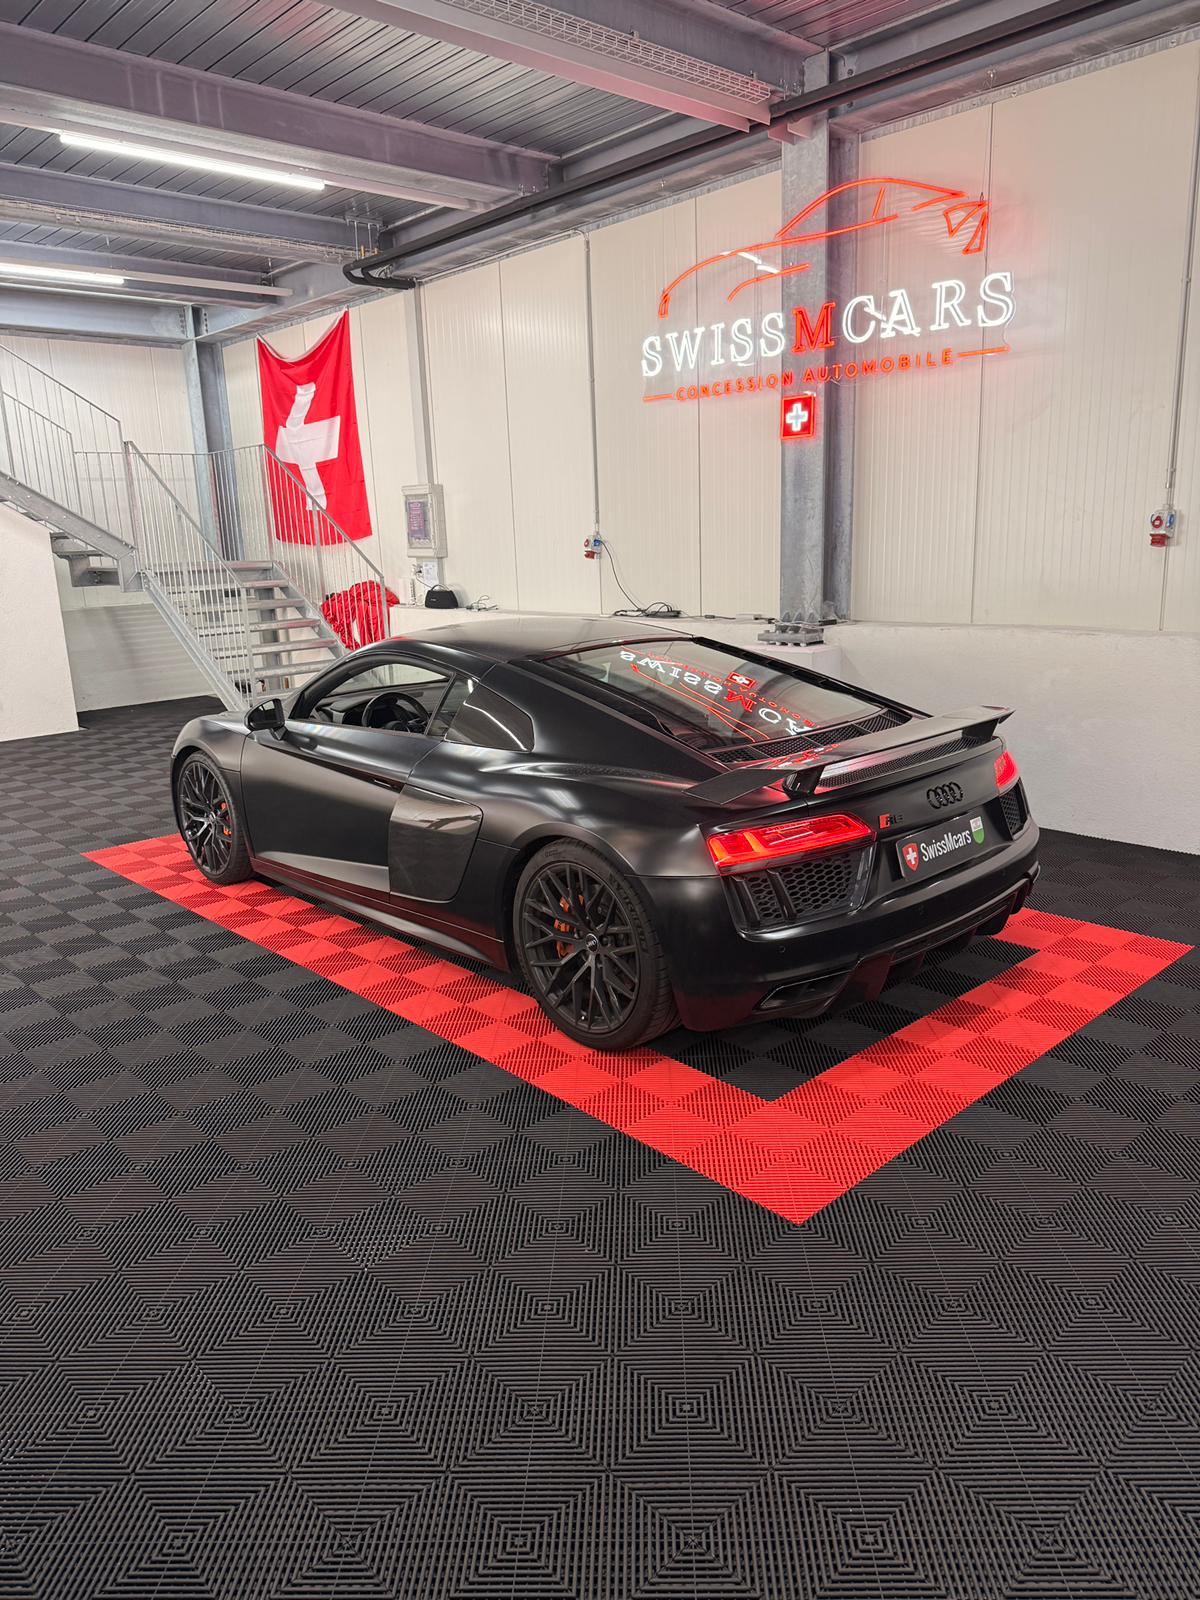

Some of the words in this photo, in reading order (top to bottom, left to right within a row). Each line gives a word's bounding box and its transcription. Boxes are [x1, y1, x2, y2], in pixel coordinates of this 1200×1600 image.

[641, 271, 1015, 377] SWISSMCARS
[675, 371, 794, 401] CONCESSION
[803, 347, 954, 383] AUTOMOBILE
[919, 829, 972, 862] SwissMcars
